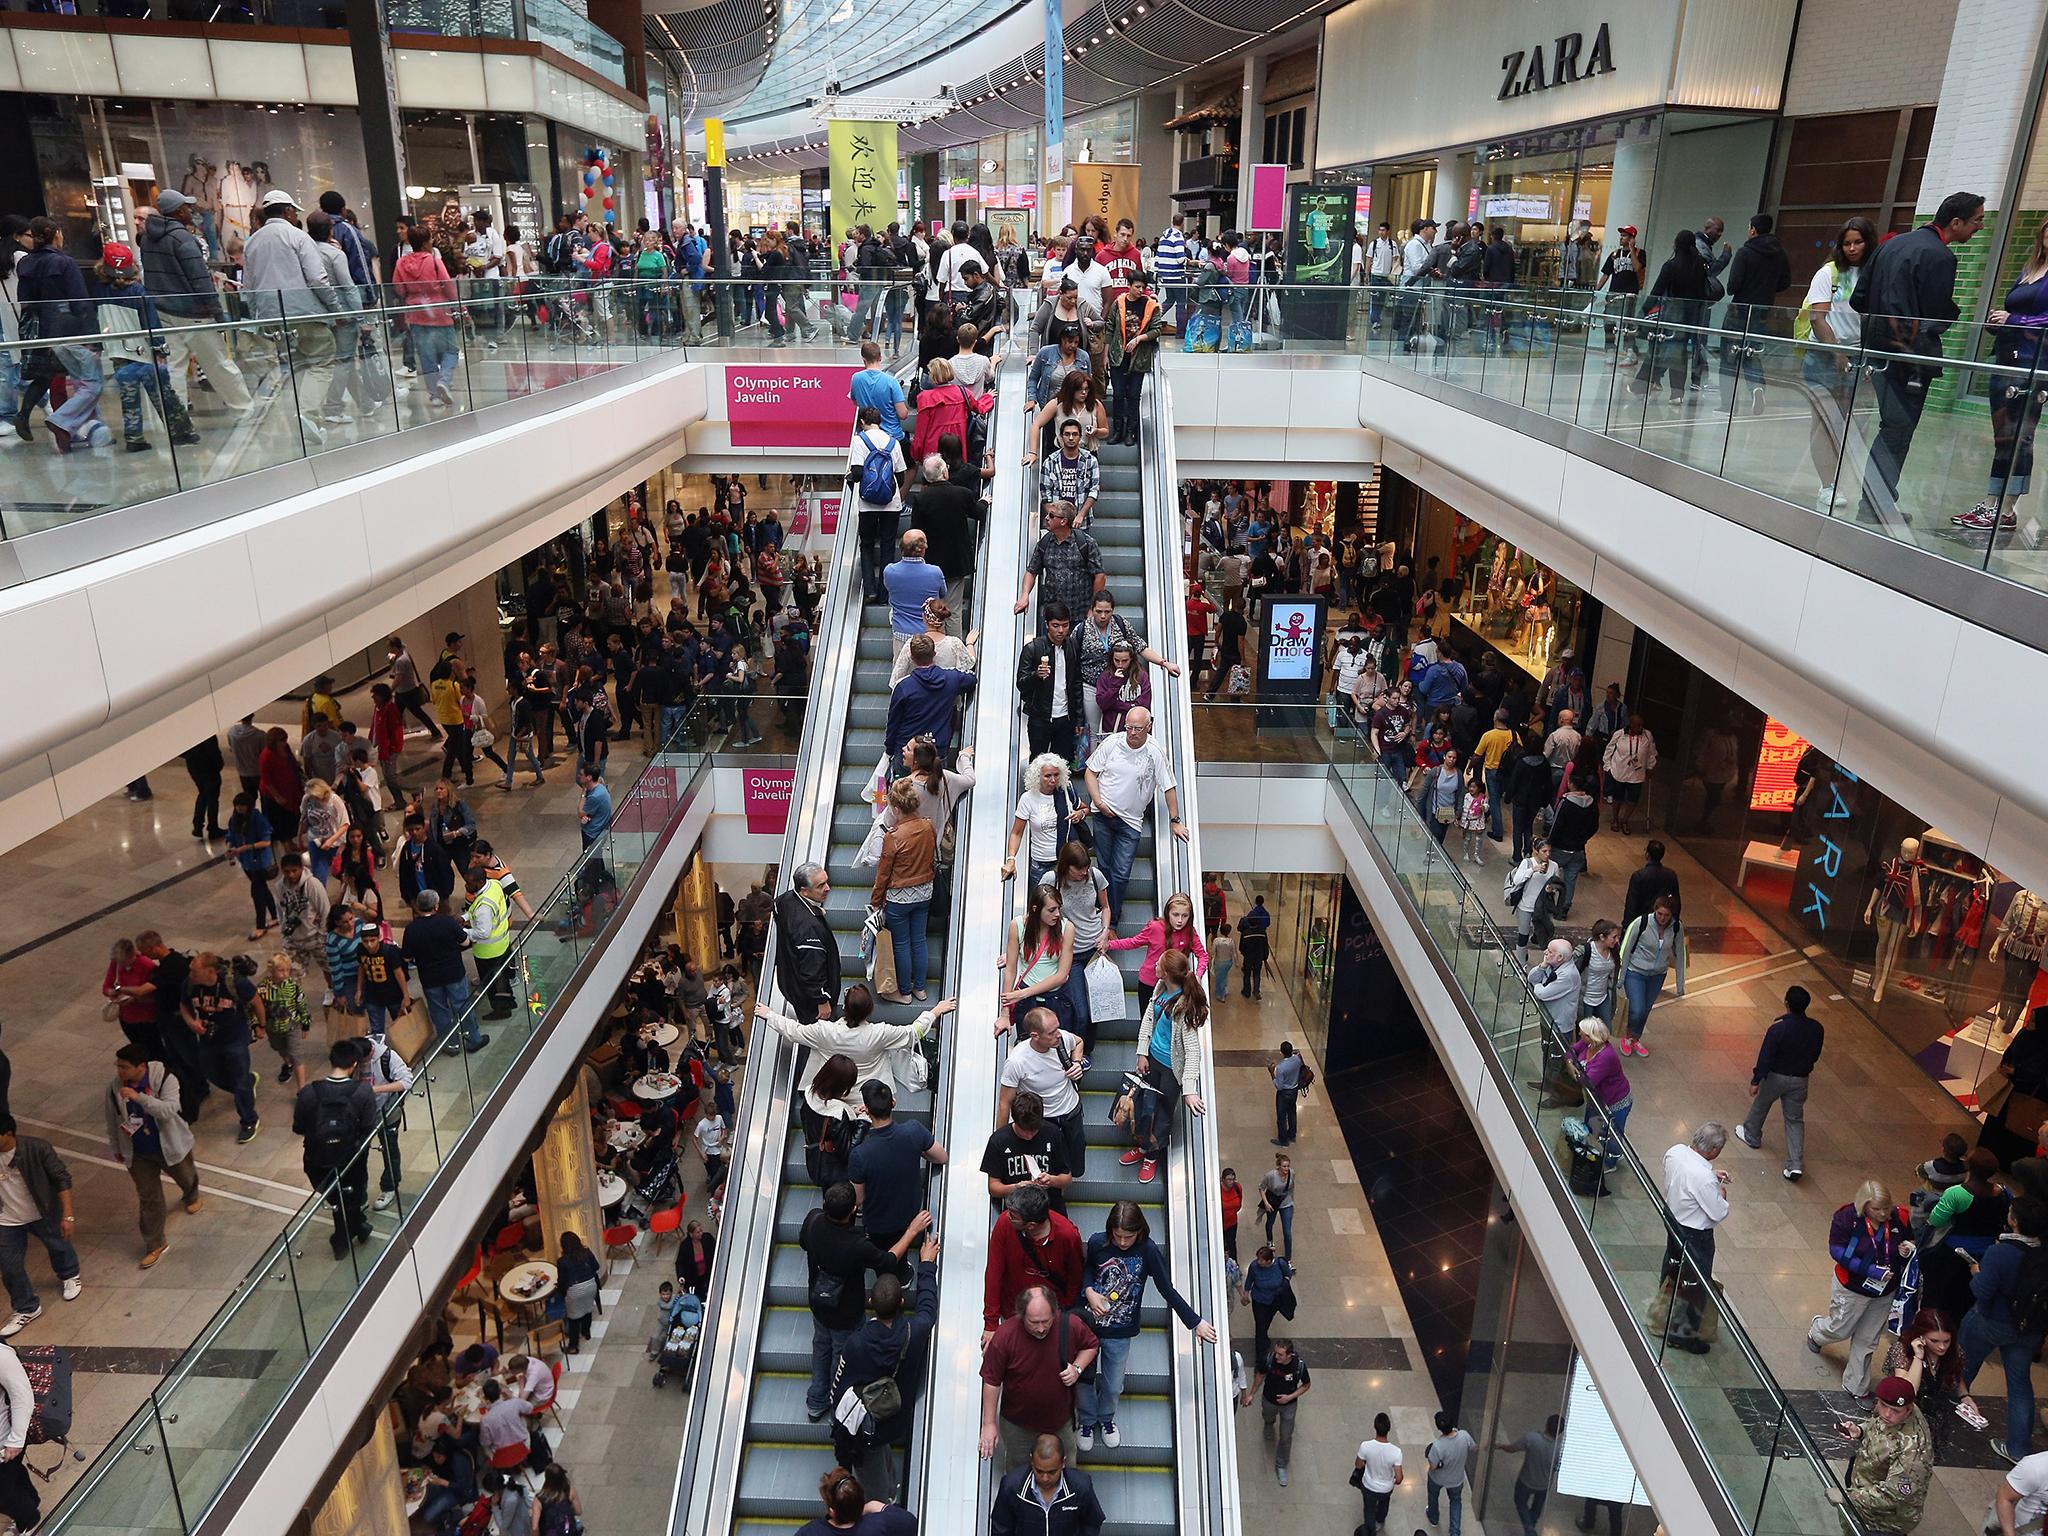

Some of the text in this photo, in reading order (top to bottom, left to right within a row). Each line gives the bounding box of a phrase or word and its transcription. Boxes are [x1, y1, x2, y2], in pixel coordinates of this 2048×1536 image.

[1497, 23, 1616, 100] ZARA
[115, 259, 122, 267] 7
[1118, 268, 1124, 278] &
[733, 376, 822, 391] Olympic Park
[734, 391, 781, 403] Javelin
[823, 503, 840, 511] Olym
[1269, 634, 1309, 647] Draw
[1275, 647, 1313, 657] more
[750, 777, 794, 790] Olympi
[1353, 948, 1385, 962] BLAC
